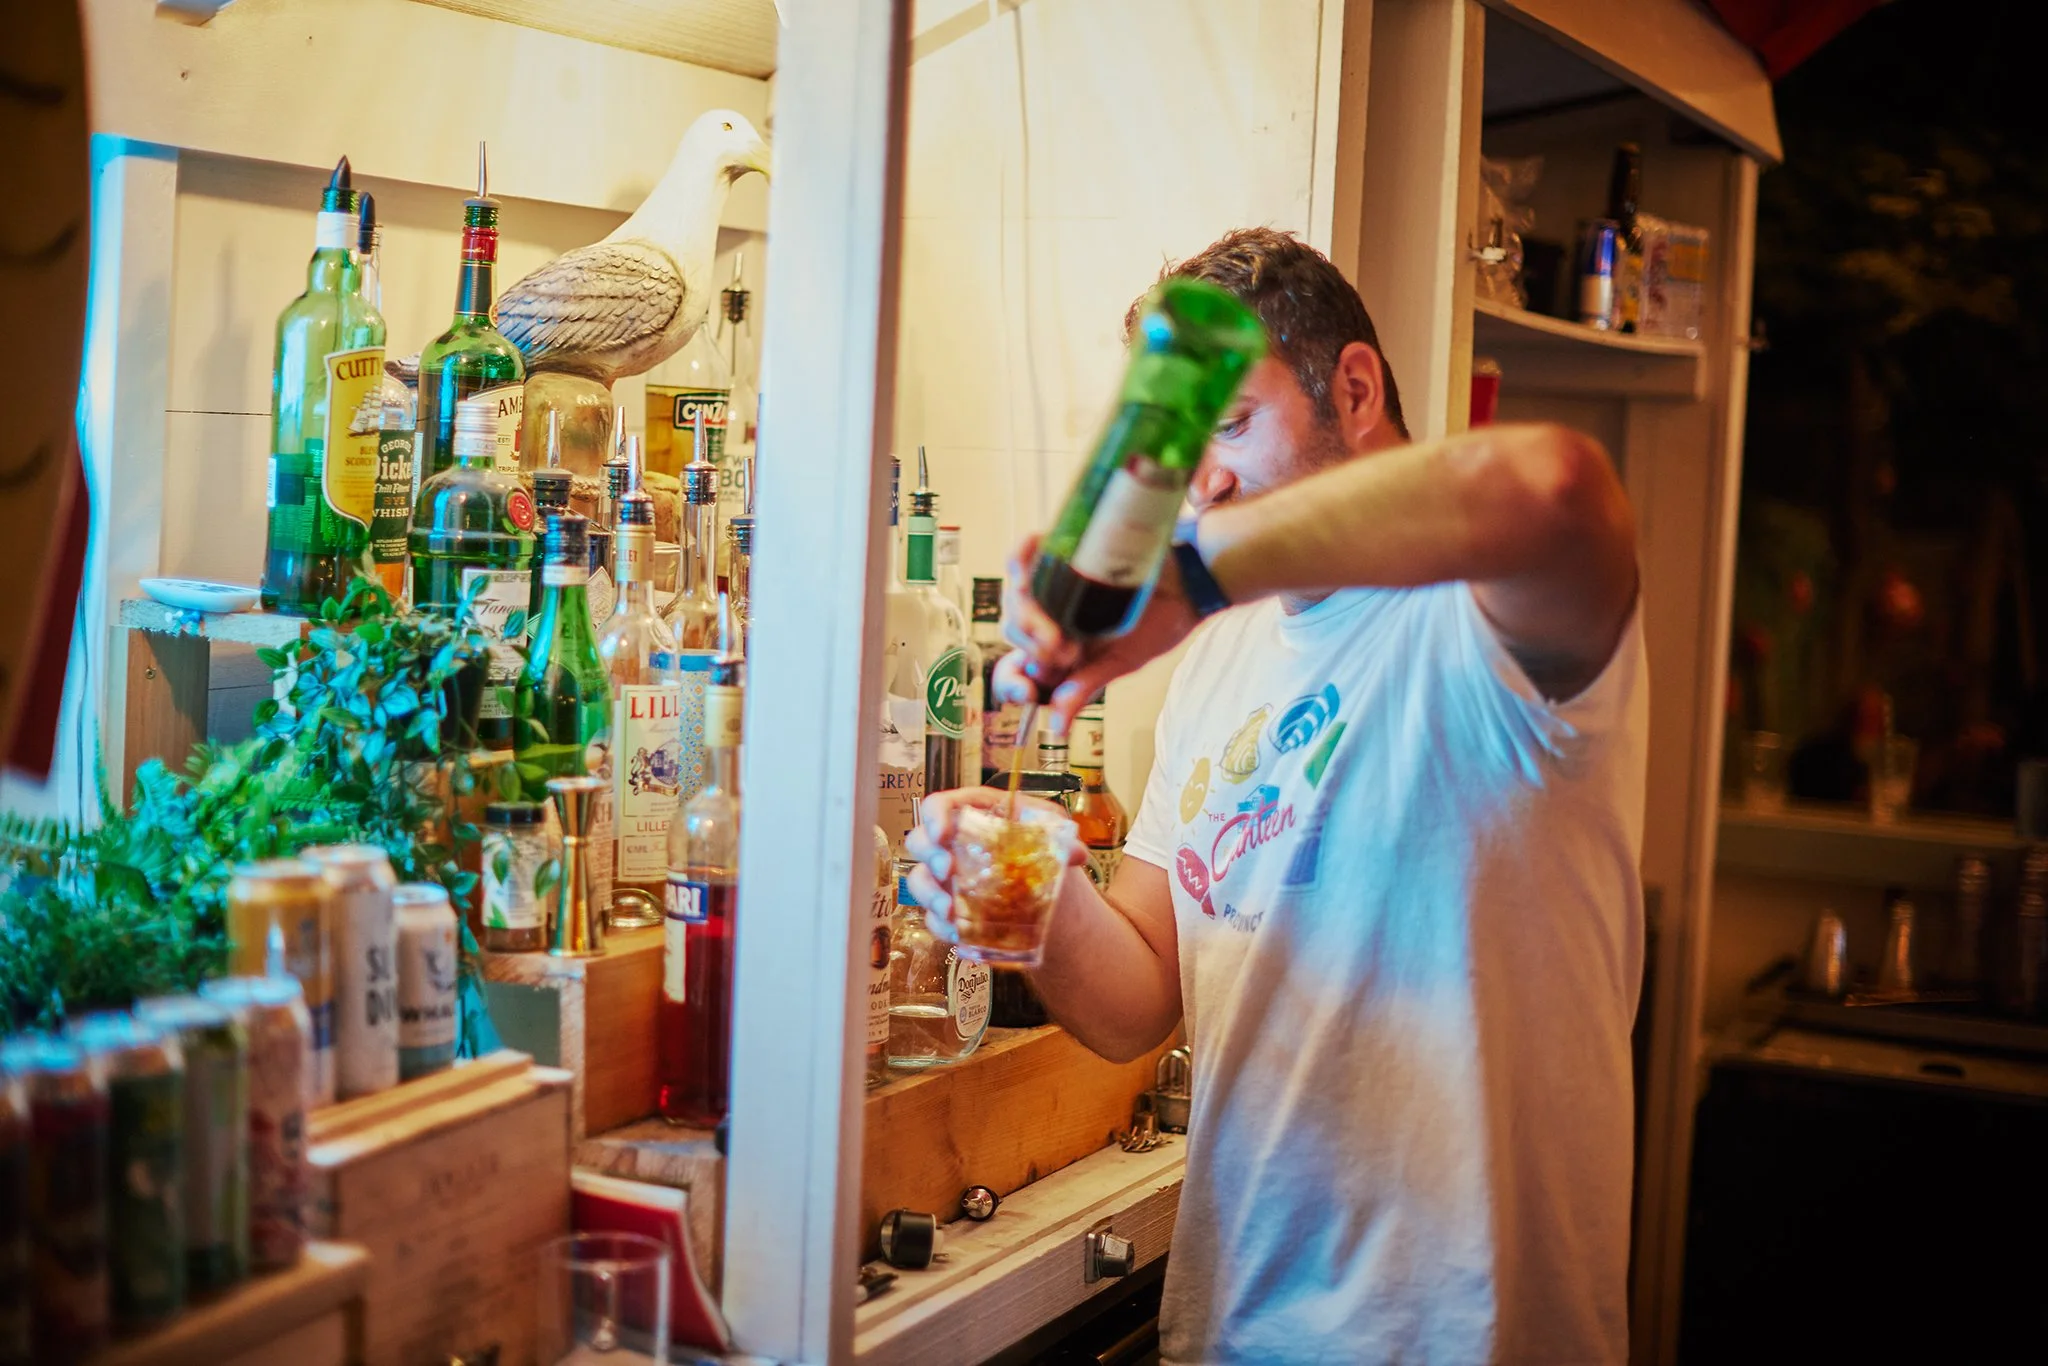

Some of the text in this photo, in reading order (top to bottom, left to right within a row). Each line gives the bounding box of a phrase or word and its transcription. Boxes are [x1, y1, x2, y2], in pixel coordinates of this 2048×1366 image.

[878, 773, 914, 789] GREY
[1208, 812, 1226, 823] THE
[1211, 795, 1297, 883] Canteen
